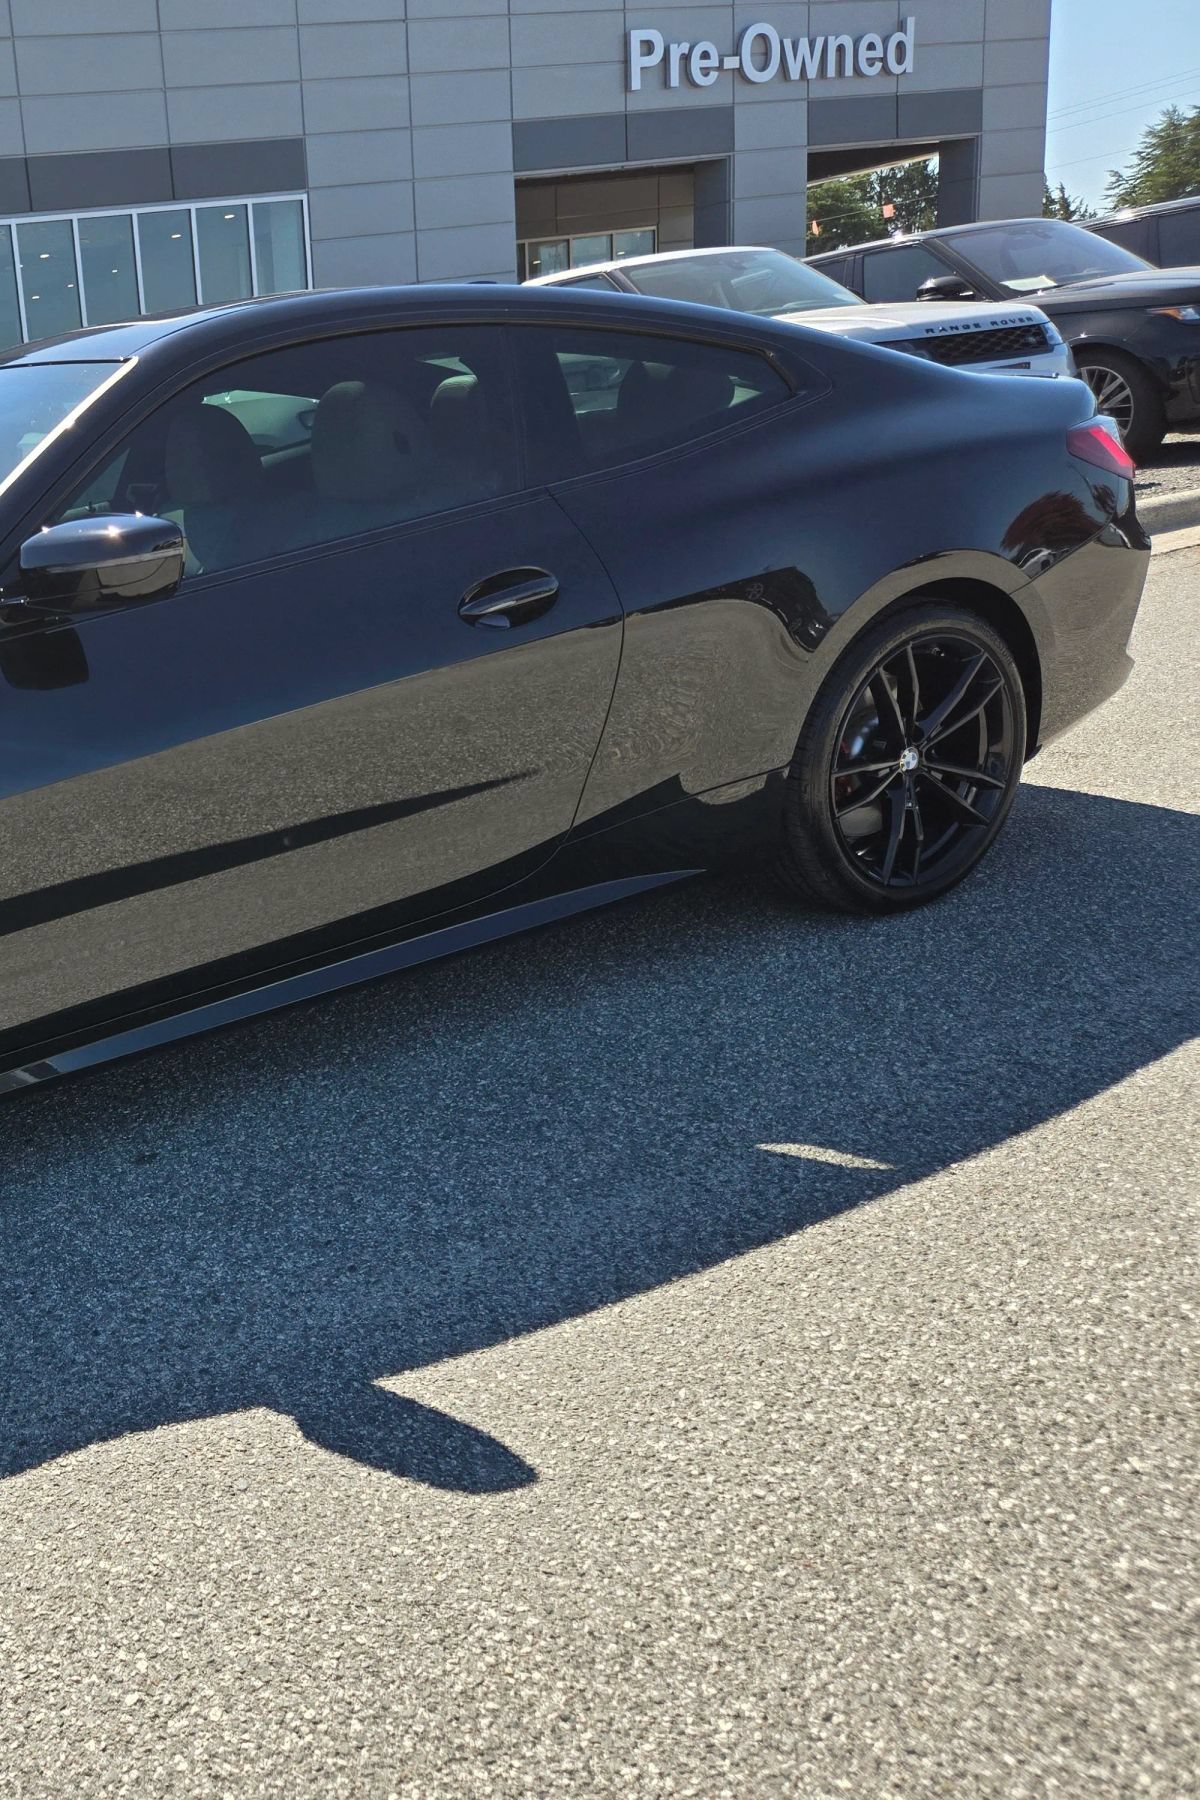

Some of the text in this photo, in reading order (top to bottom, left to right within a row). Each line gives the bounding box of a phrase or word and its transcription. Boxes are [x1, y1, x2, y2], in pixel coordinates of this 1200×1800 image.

[628, 16, 915, 91] Pre-Owned
[925, 316, 1034, 334] RANGE ROVER
